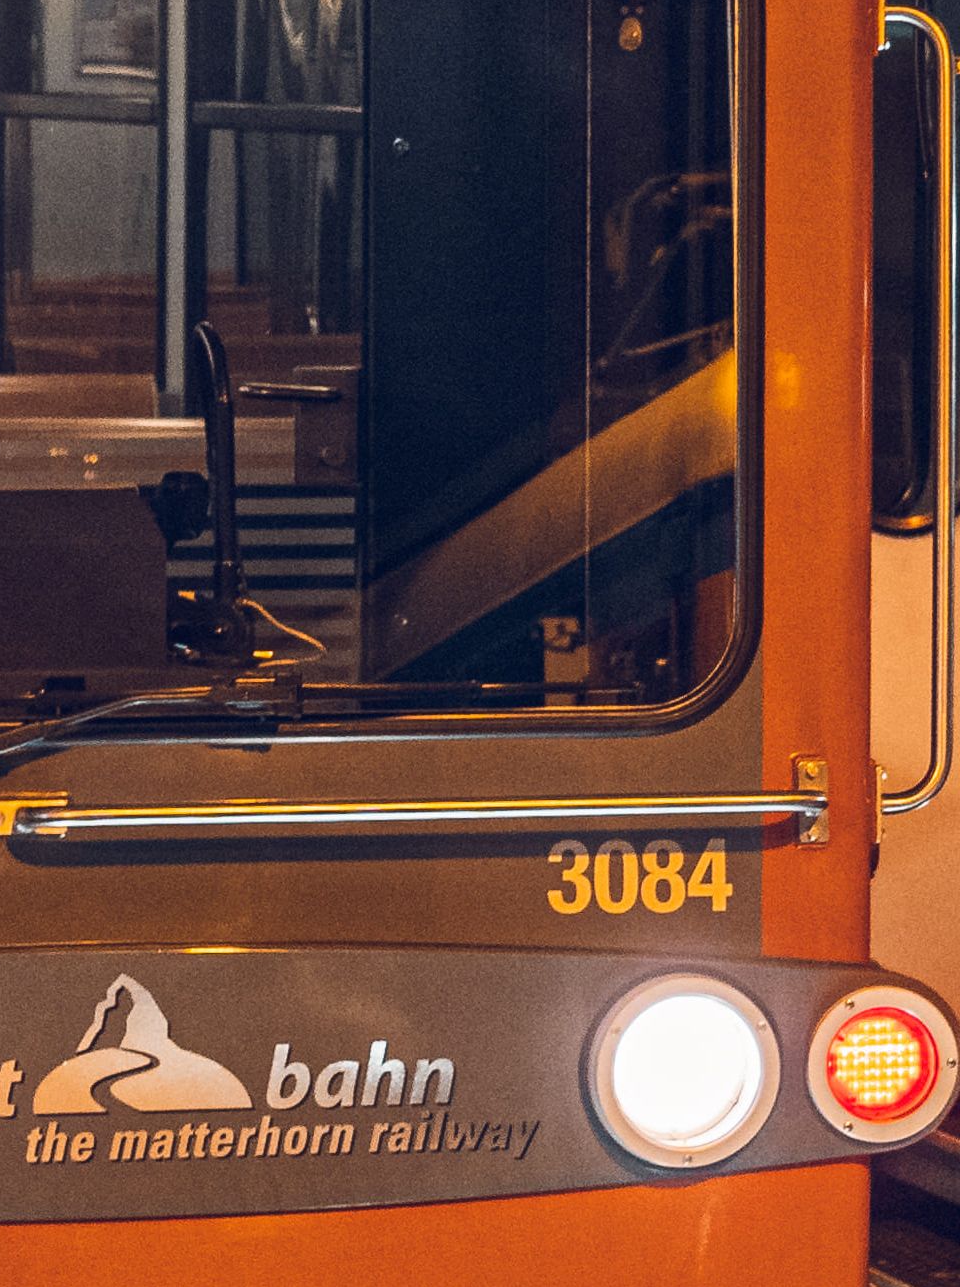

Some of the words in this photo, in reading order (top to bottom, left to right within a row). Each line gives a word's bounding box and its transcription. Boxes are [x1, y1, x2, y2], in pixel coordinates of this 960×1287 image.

[547, 838, 733, 914] 3084
[266, 1040, 455, 1110] bahn
[26, 1120, 96, 1163] the
[108, 1115, 354, 1160] matterhorn
[369, 1110, 539, 1160] railway
